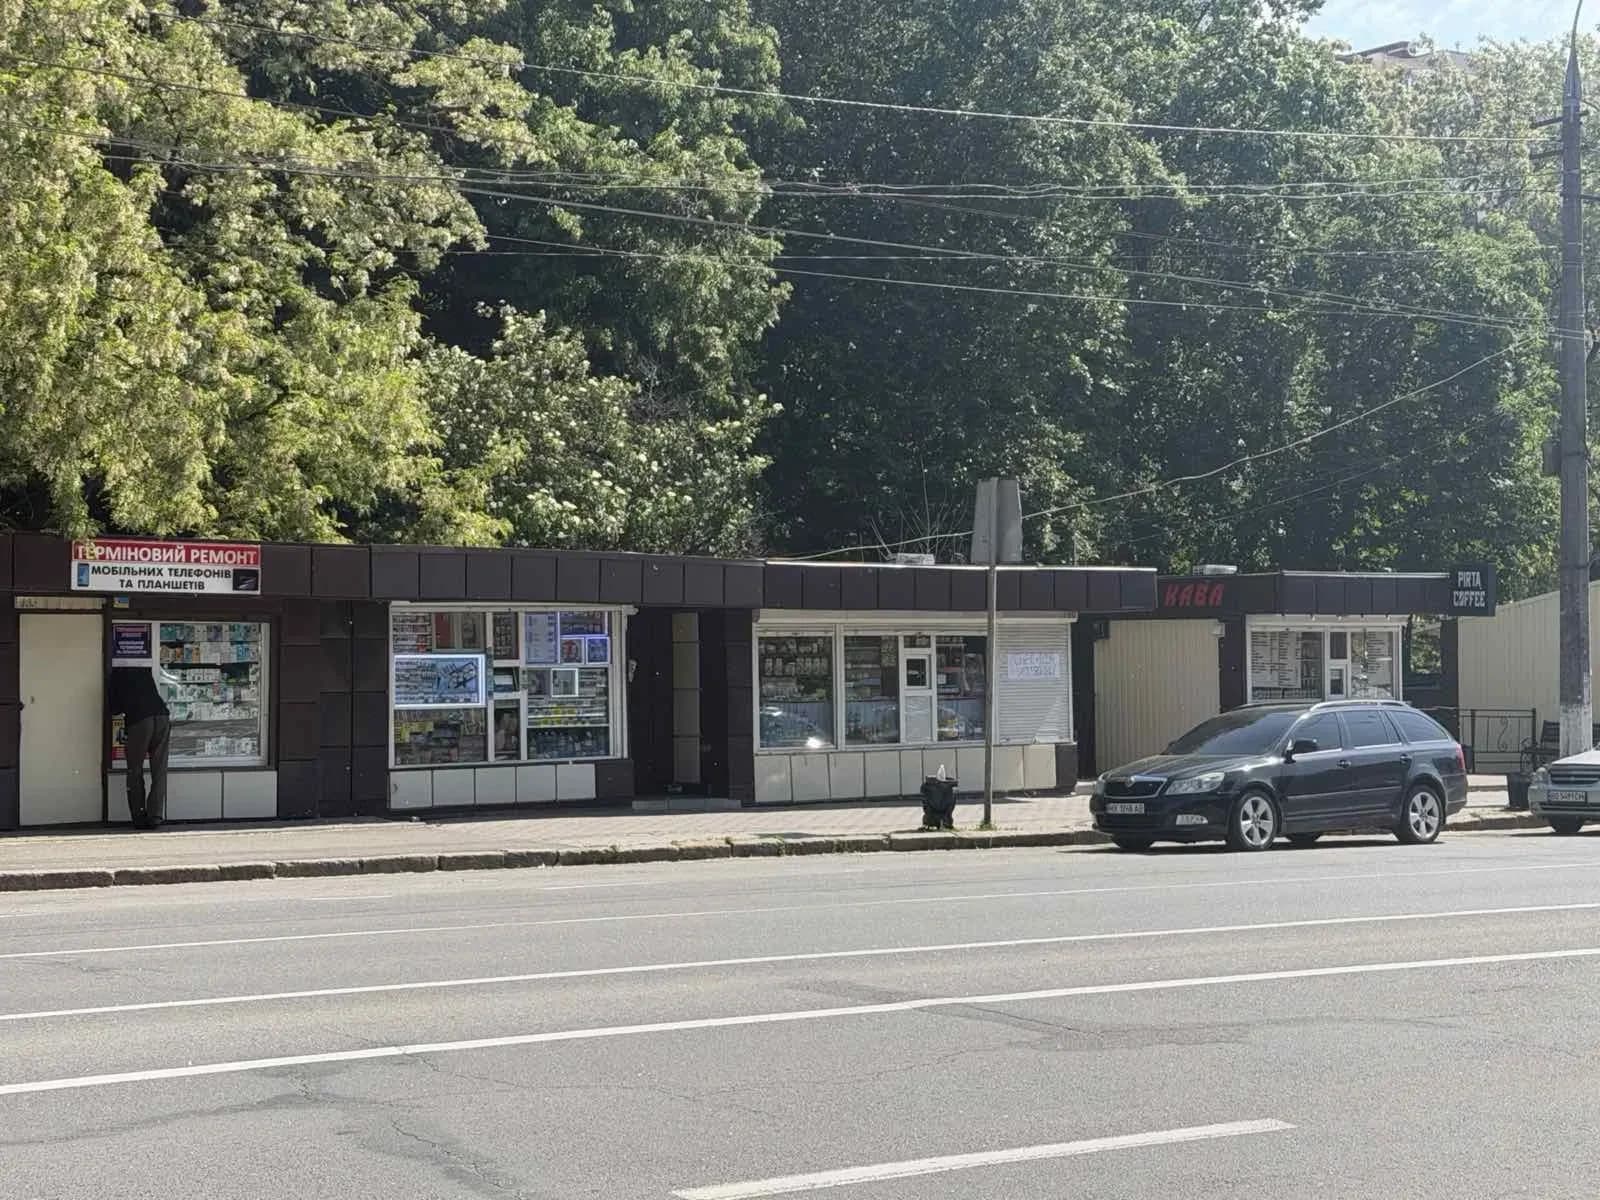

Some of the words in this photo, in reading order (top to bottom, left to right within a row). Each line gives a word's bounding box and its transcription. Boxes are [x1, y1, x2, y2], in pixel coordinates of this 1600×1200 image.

[190, 548, 256, 565] РЕМОНТ
[91, 564, 164, 577] МОБІЛЬНИХ
[168, 567, 232, 579] ТЕЛЕФОНІВ
[1457, 571, 1481, 588] PIRTA
[119, 579, 134, 589] ТА
[137, 579, 206, 591] ПЛАНШЕТІВ
[1164, 583, 1225, 608] КАВА
[1453, 590, 1486, 608] COFFEE
